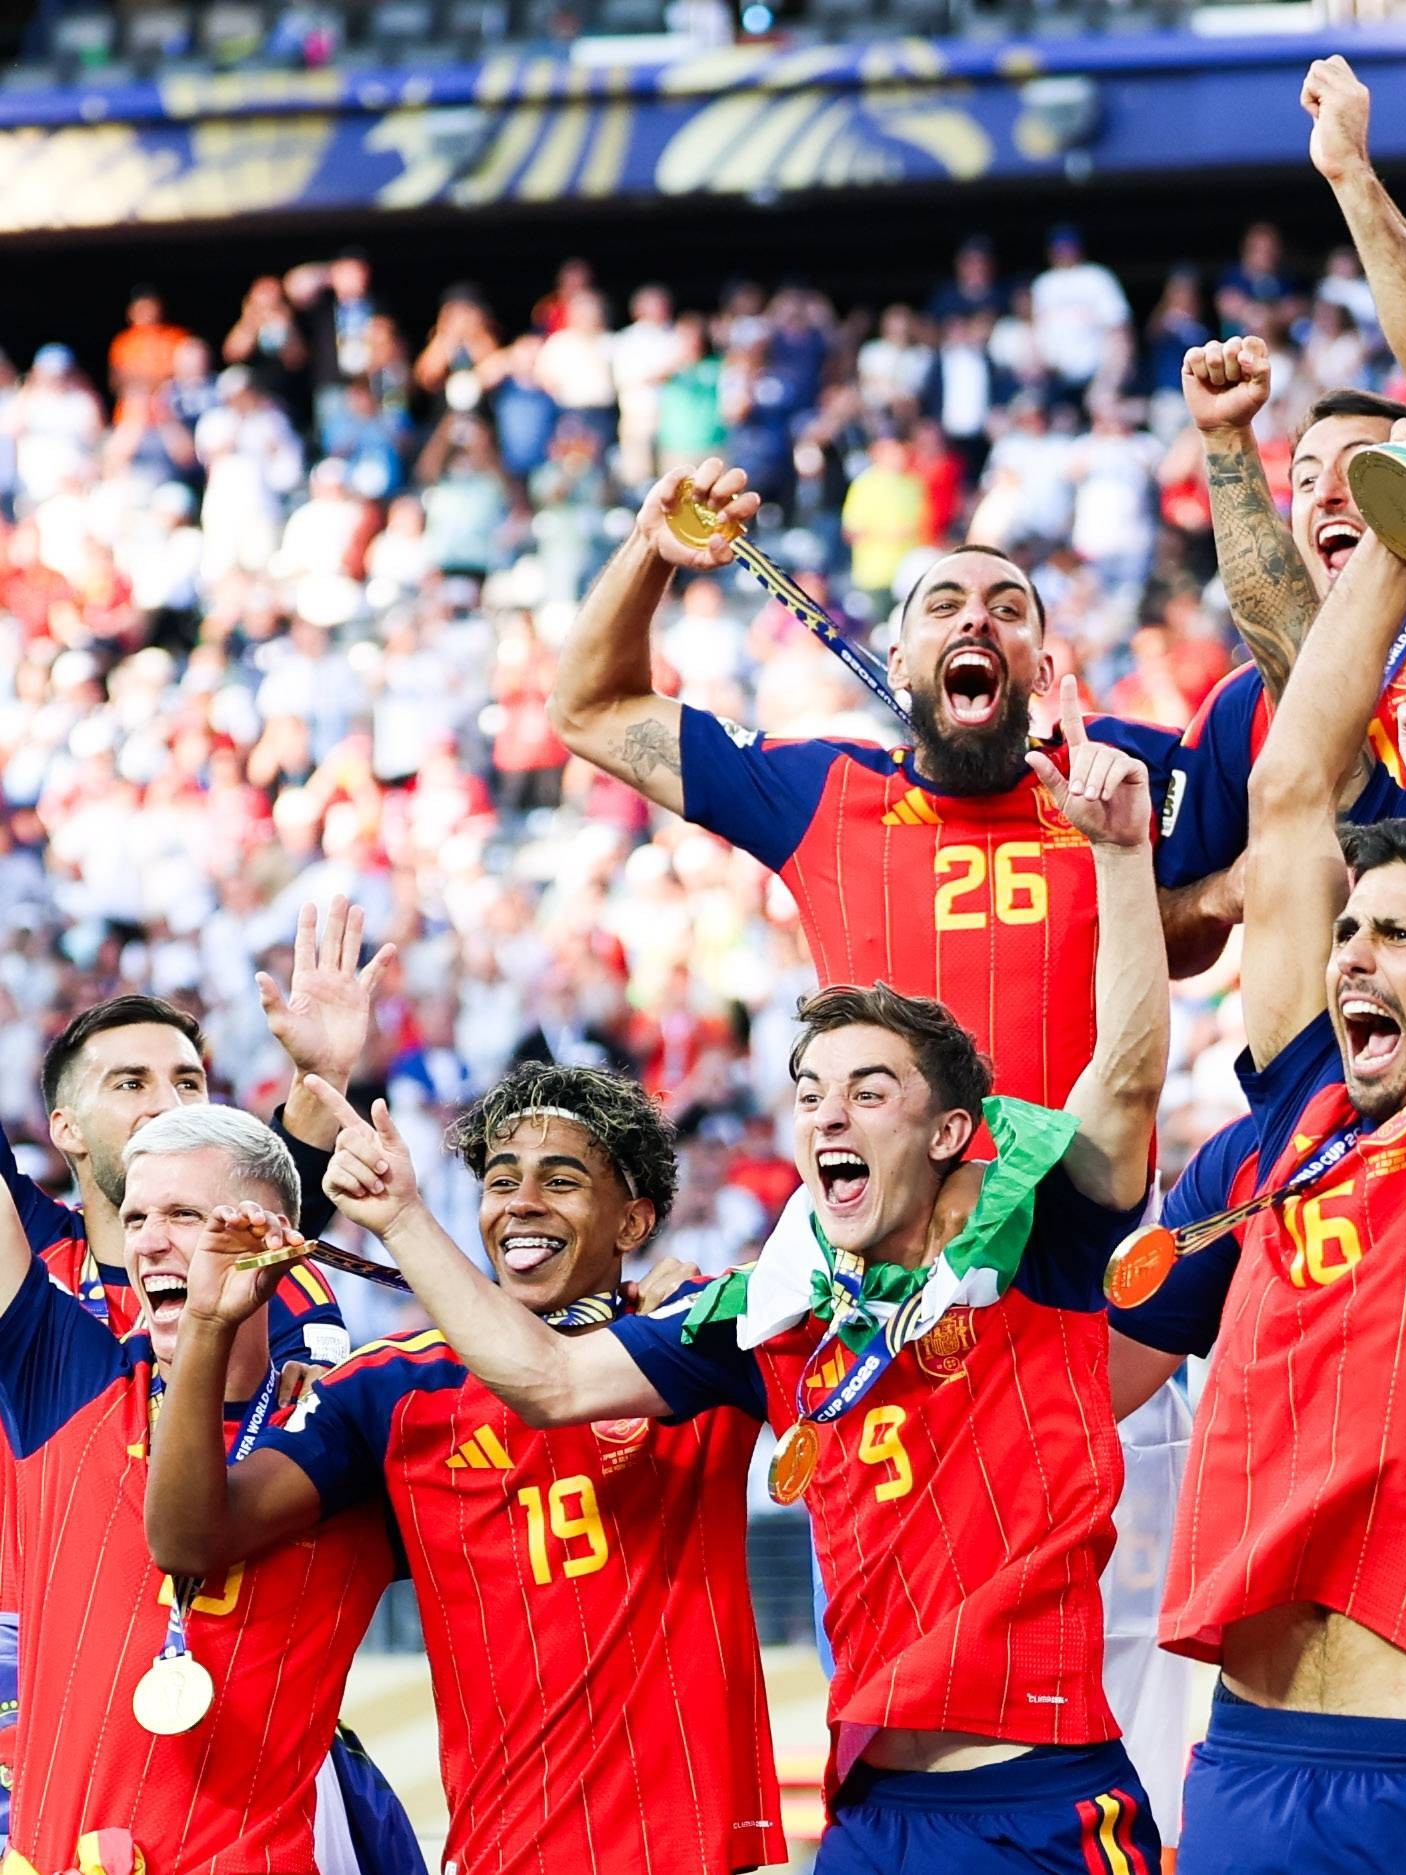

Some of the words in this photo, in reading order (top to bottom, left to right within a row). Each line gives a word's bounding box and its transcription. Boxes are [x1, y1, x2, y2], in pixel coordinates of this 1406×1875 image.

[840, 649, 879, 690] 2026
[934, 841, 1048, 931] 26
[1320, 1141, 1346, 1166] CUP
[1283, 1180, 1363, 1288] 16
[235, 1434, 255, 1461] FIFA
[247, 1391, 269, 1435] WORLD
[816, 1399, 843, 1423] CUP
[840, 1355, 881, 1400] 2026
[858, 1404, 913, 1504] 9
[517, 1474, 609, 1585] 19
